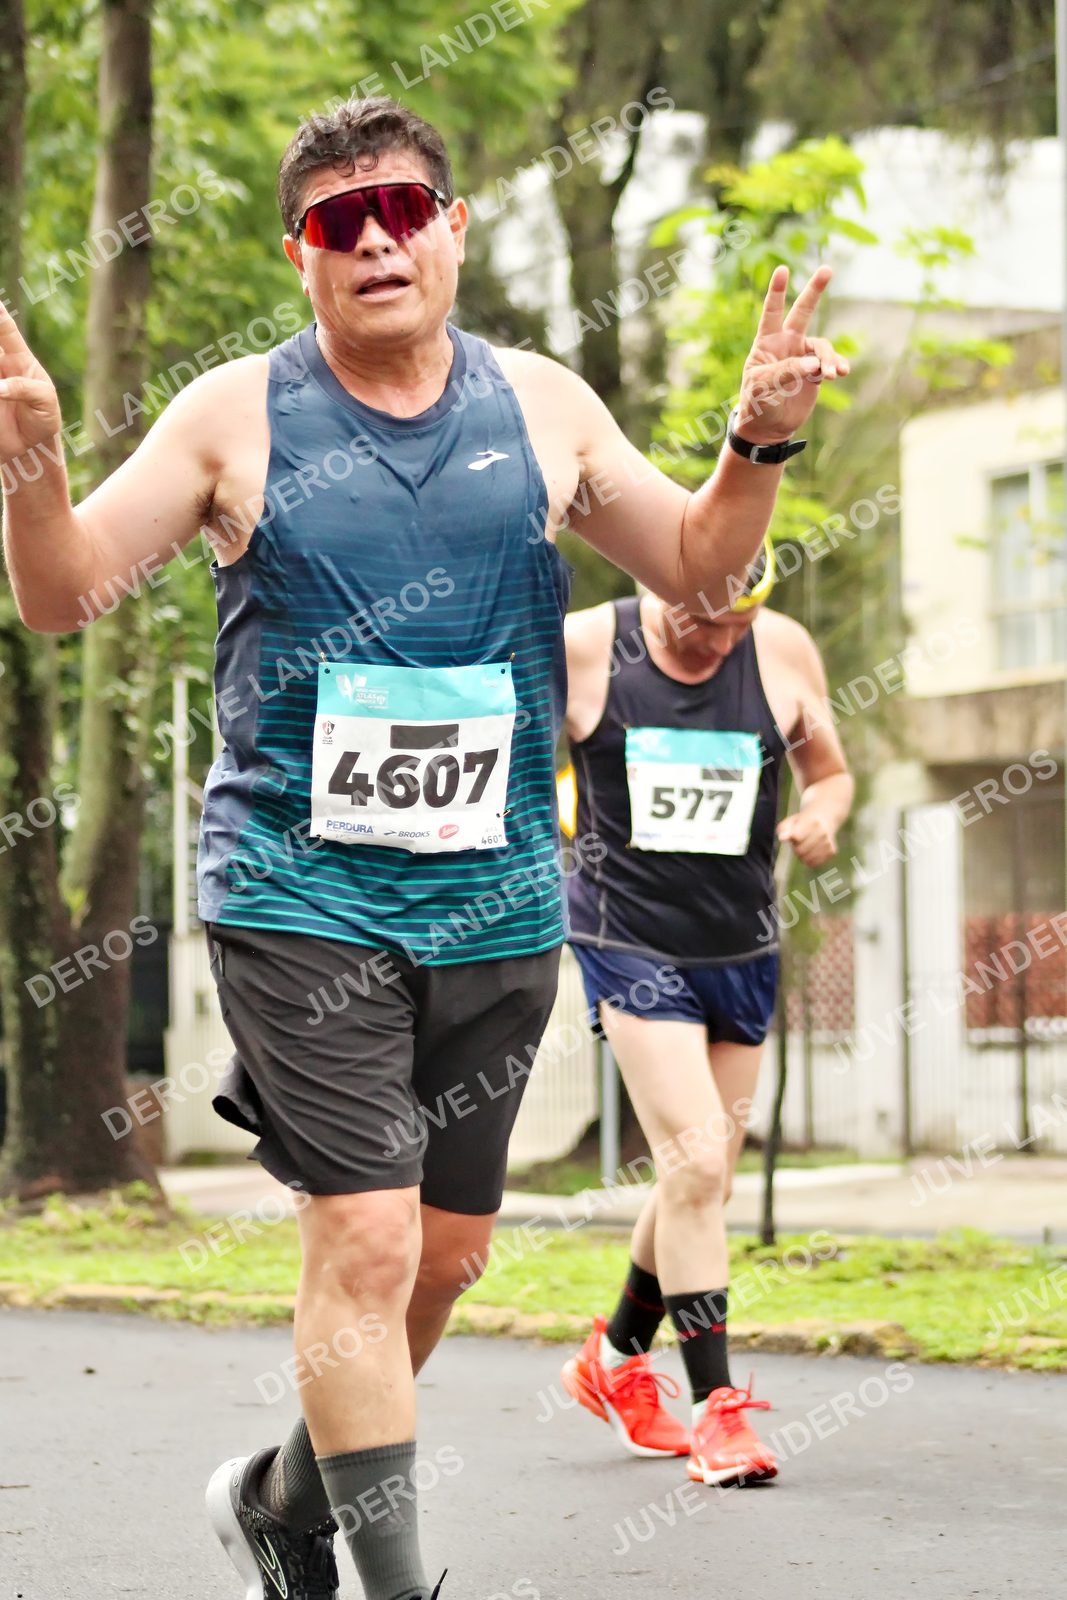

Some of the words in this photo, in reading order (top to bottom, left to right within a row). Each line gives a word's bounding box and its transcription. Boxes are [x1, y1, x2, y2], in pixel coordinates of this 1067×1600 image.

[328, 748, 499, 809] 4607
[650, 786, 733, 821] 577
[326, 819, 374, 834] PERDURA
[398, 830, 431, 839] BROOKS
